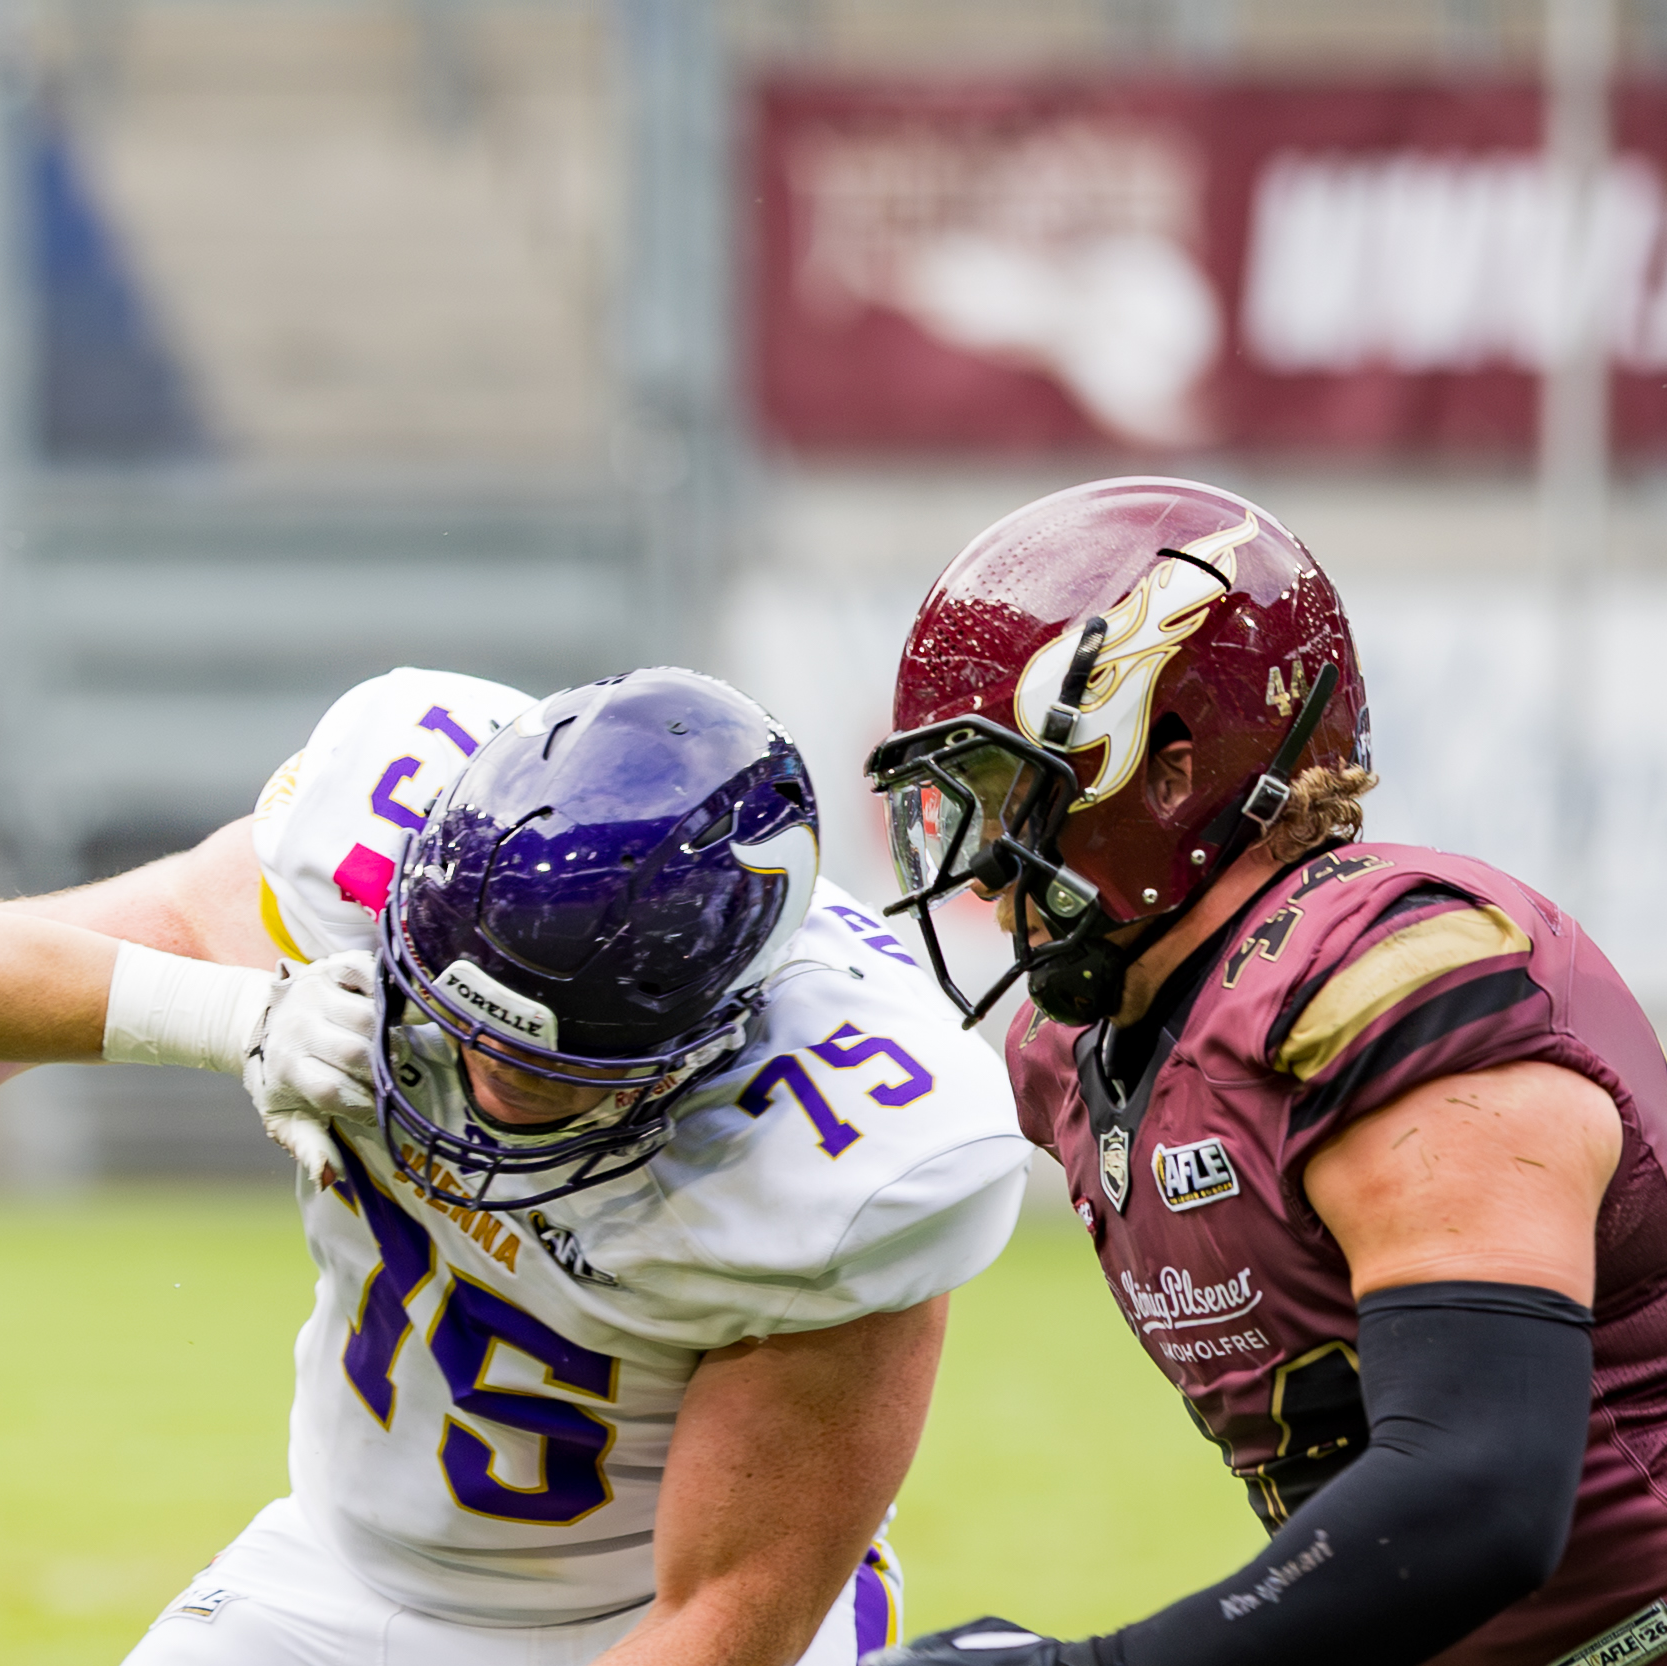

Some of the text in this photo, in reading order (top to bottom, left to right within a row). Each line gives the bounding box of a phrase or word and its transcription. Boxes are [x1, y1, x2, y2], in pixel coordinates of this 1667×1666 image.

[1221, 851, 1397, 990] 44
[445, 973, 543, 1038] FORELLE
[734, 1019, 935, 1161] 75
[1166, 1146, 1229, 1198] AFLE
